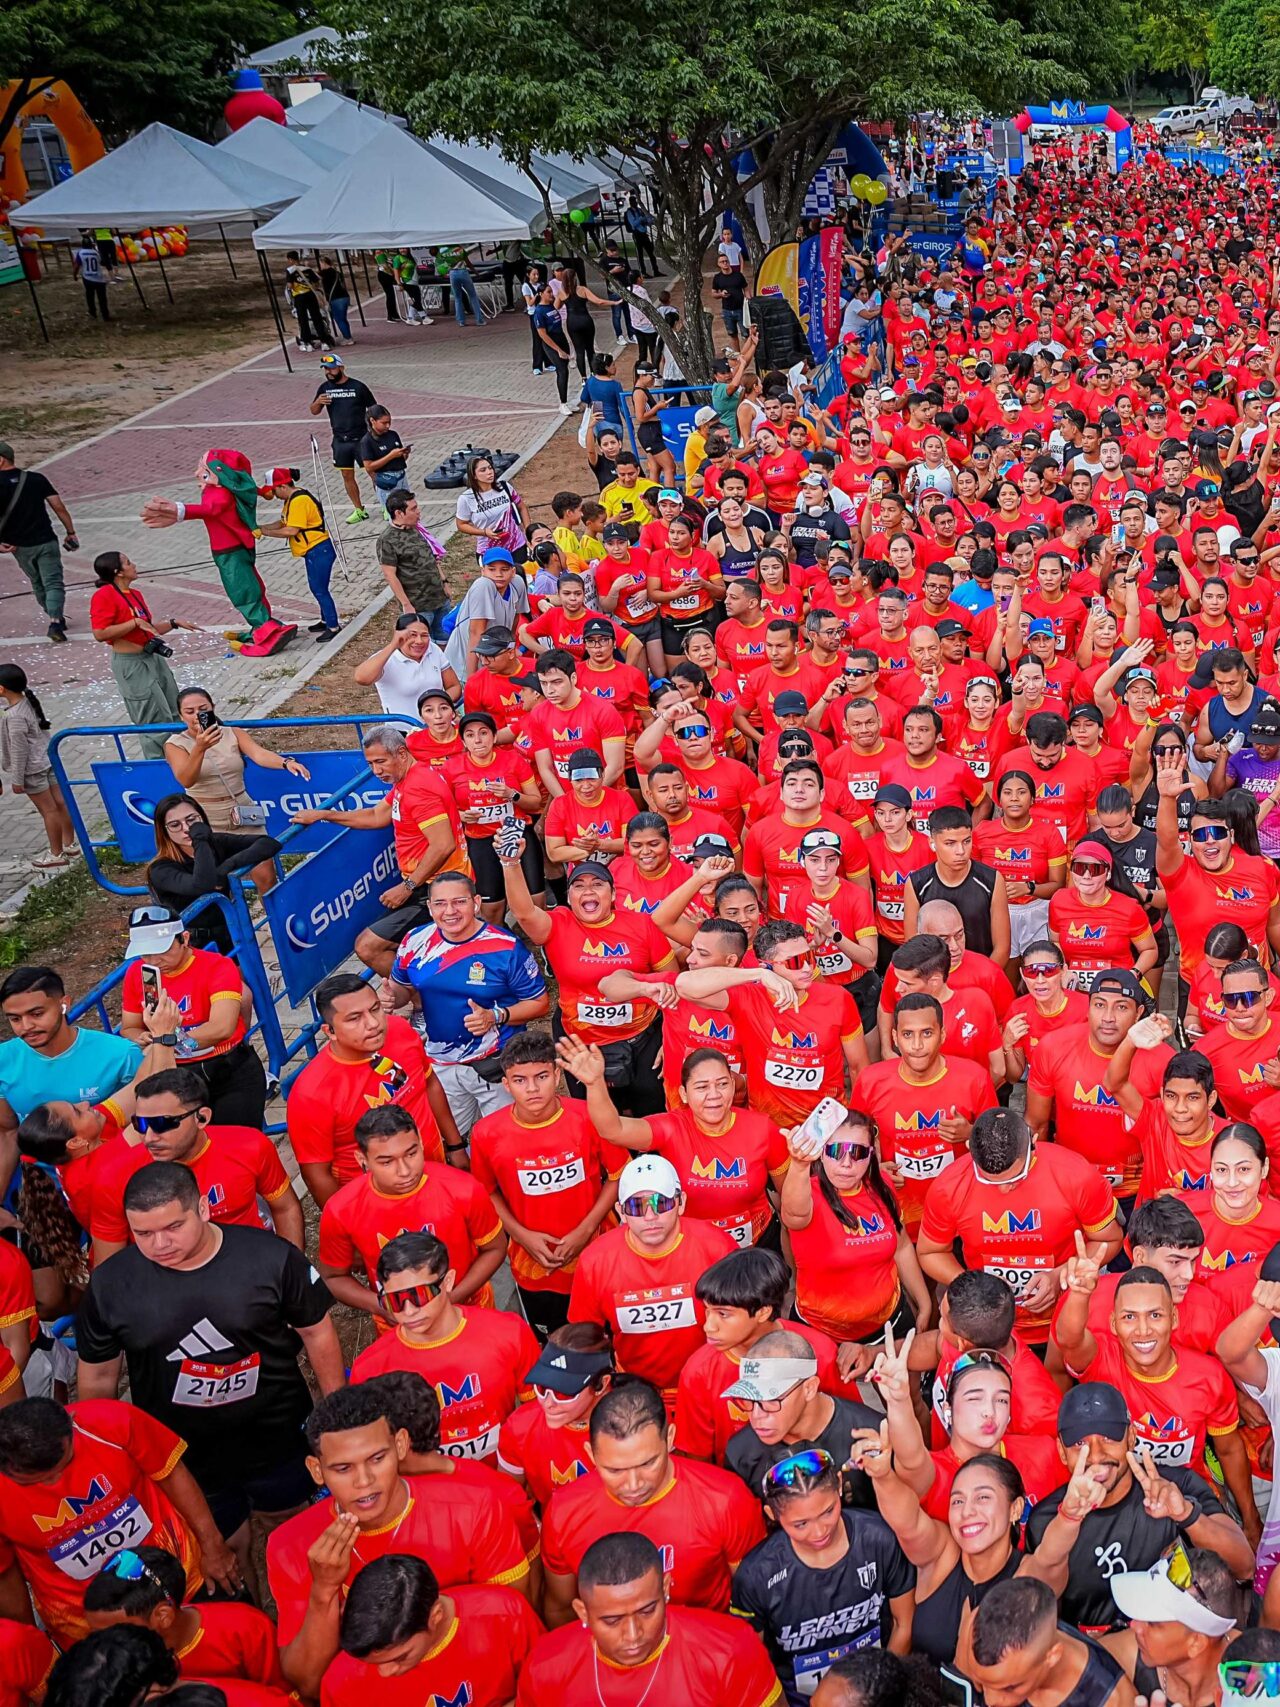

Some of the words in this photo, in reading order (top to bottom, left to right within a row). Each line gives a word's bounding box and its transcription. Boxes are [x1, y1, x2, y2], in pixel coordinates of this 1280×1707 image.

[310, 871, 373, 937] Super
[584, 1005, 628, 1021] 2894
[771, 1063, 817, 1083] 2270
[904, 1155, 944, 1172] 2157
[526, 1165, 578, 1187] 2025
[671, 1286, 684, 1296] 5K
[628, 1302, 684, 1326] 2327
[240, 1359, 252, 1369] 5K
[187, 1371, 248, 1398] 2145
[478, 1420, 491, 1432] 5K
[1178, 1428, 1189, 1438] 5K
[112, 1502, 131, 1520] 10K
[72, 1517, 142, 1568] 1402
[780, 1591, 886, 1640] LEGION
[856, 1634, 872, 1650] 10K
